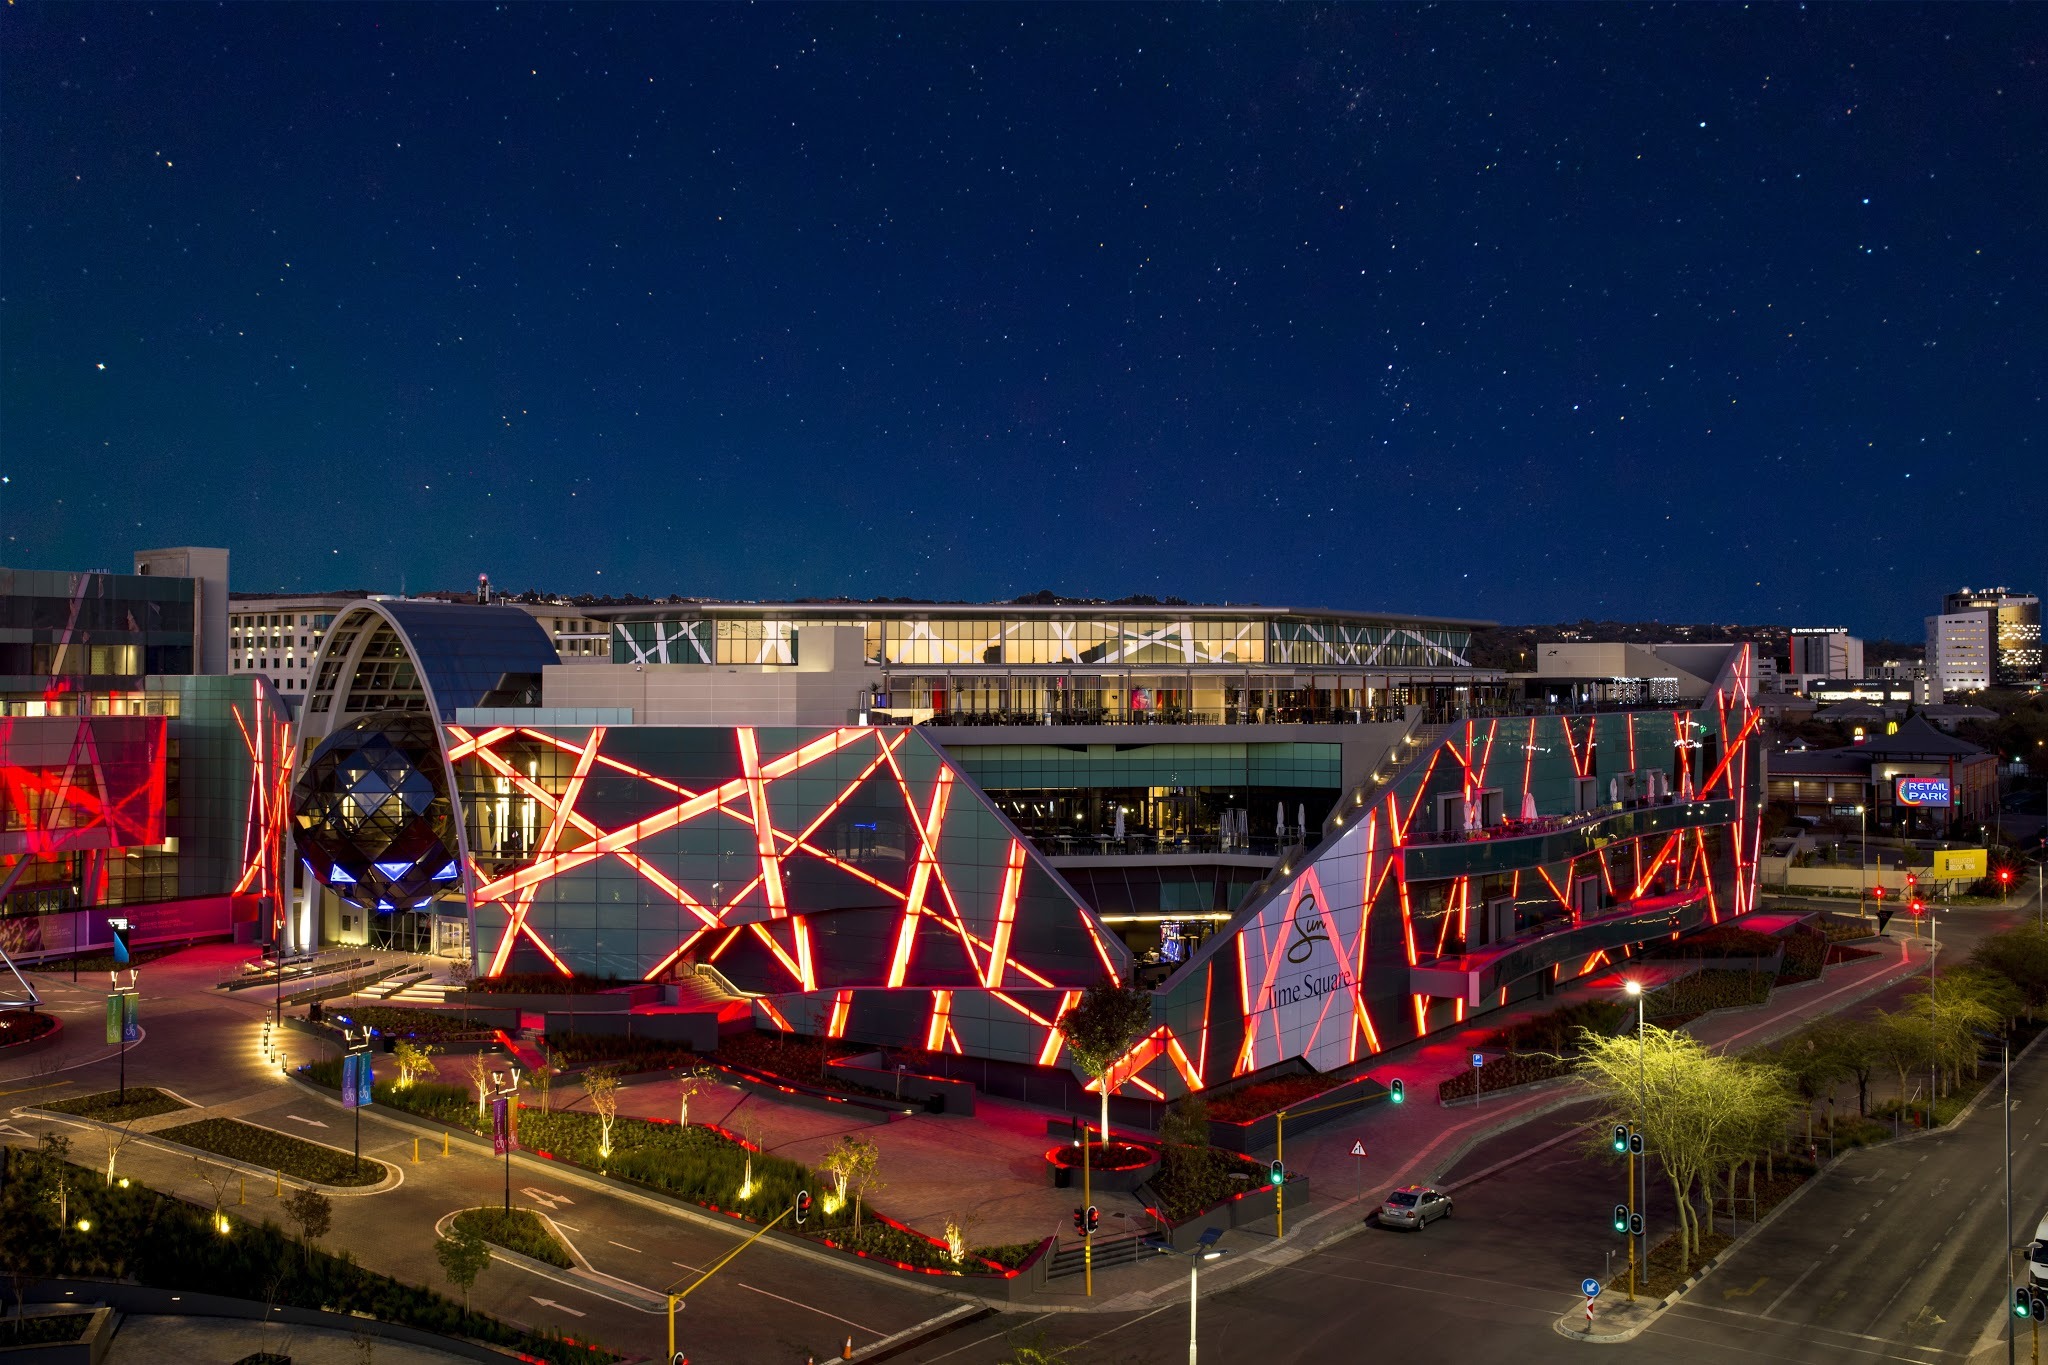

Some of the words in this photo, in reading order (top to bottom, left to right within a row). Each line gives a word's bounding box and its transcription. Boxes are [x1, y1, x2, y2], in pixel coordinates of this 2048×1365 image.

[1909, 792, 1948, 800] PARK
[1287, 893, 1330, 964] Sun
[1264, 984, 1300, 1010] Time
[1303, 970, 1352, 1001] Square
